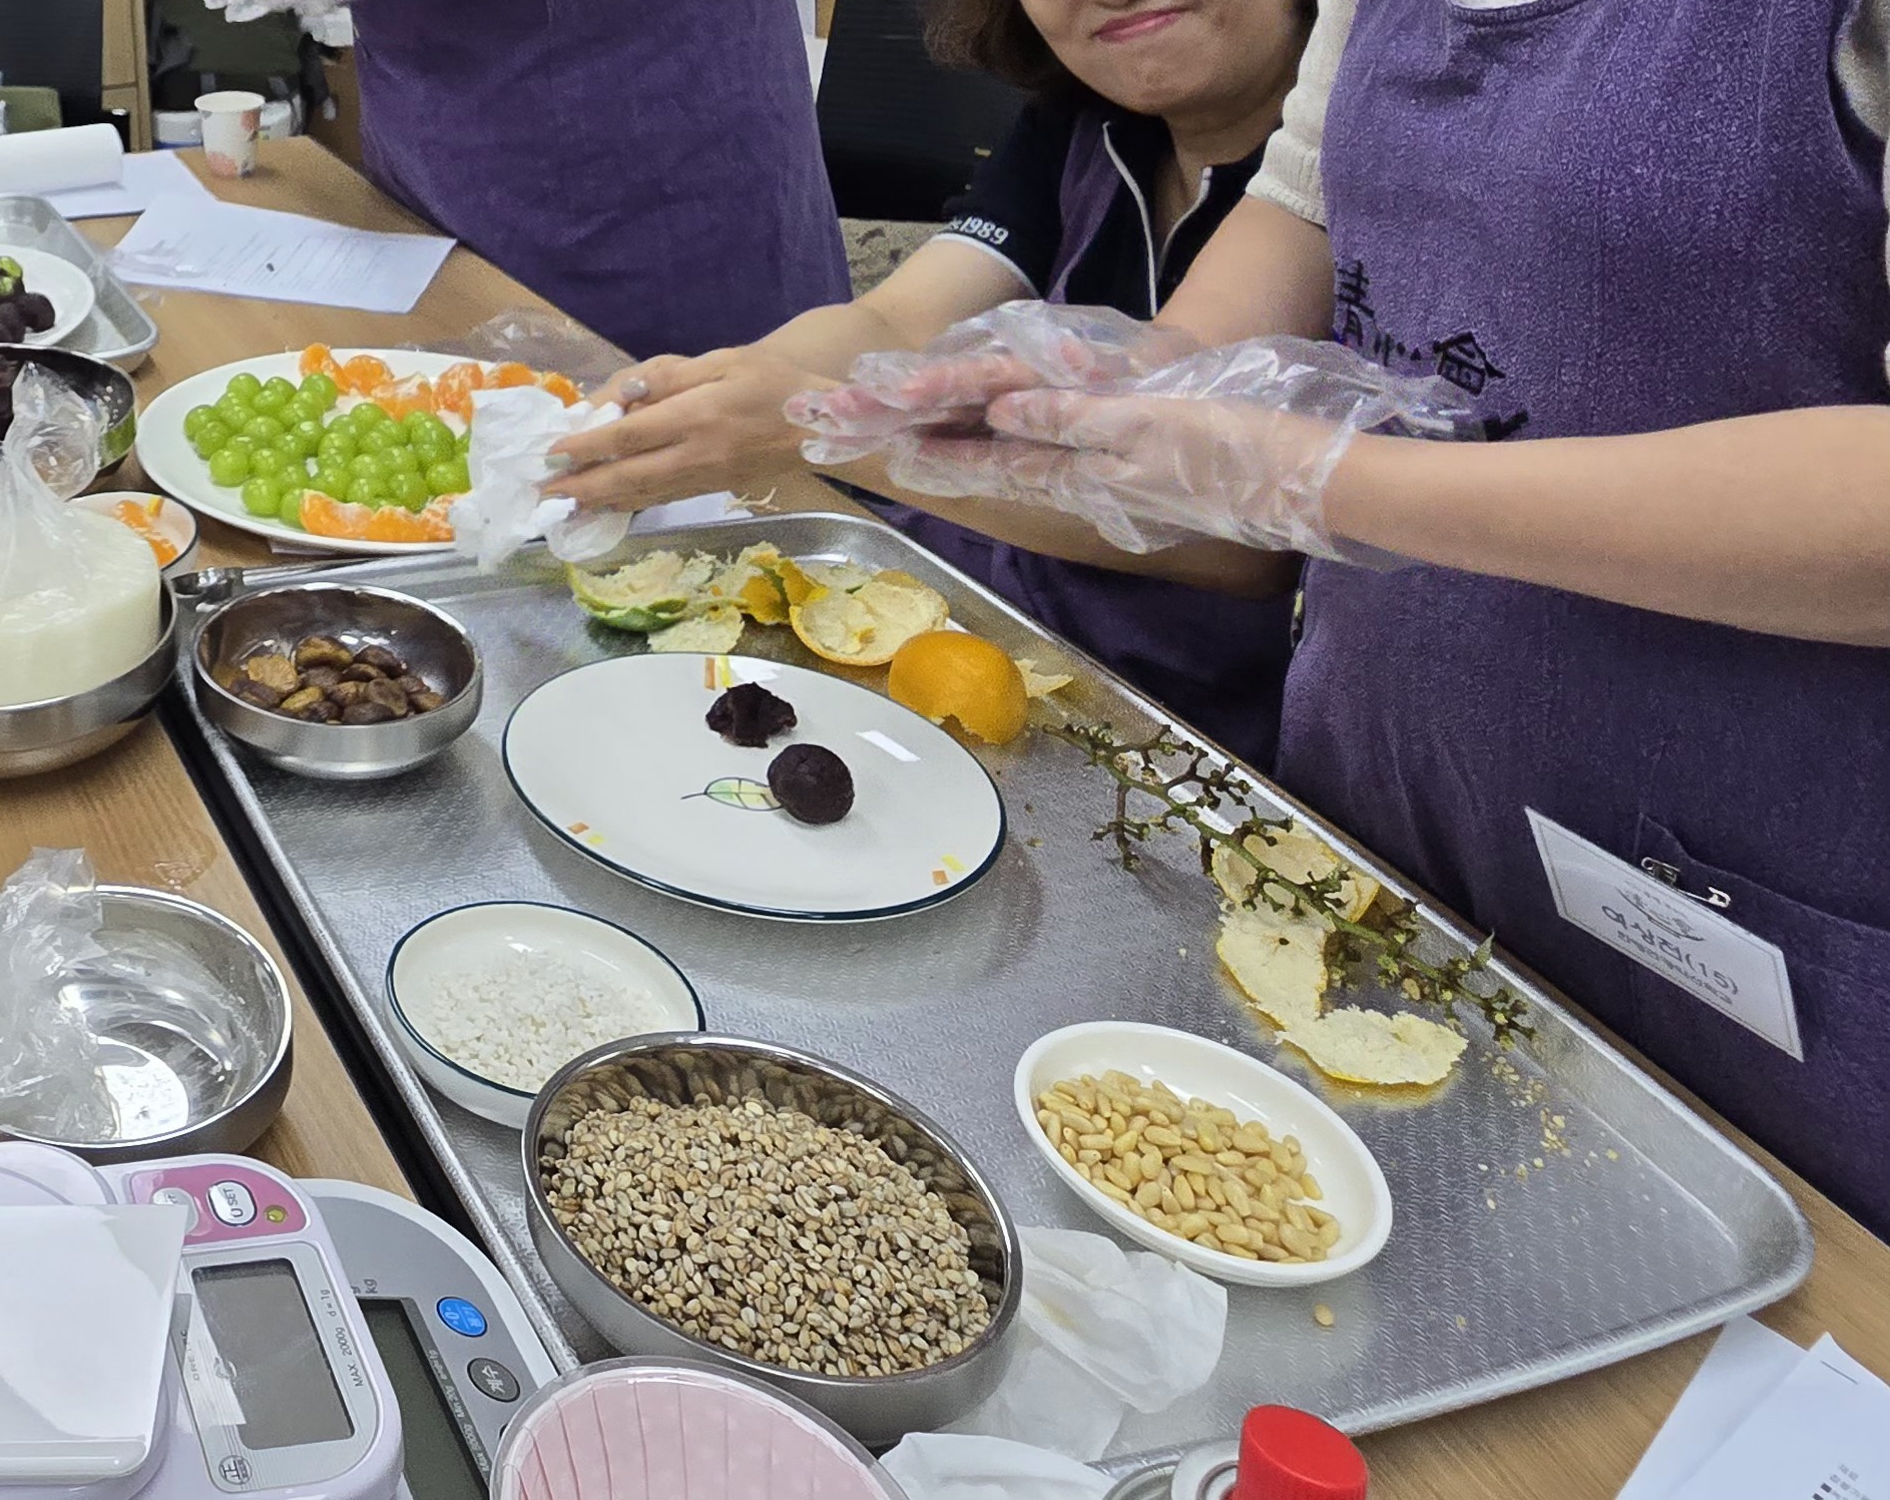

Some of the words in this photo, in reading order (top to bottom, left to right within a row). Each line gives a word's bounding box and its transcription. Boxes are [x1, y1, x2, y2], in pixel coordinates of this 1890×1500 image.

[960, 216, 1009, 245] 1989
[223, 1188, 238, 1206] SET
[363, 1278, 378, 1294] kg
[335, 1327, 352, 1356] 2000g
[347, 1364, 364, 1387] MAX
